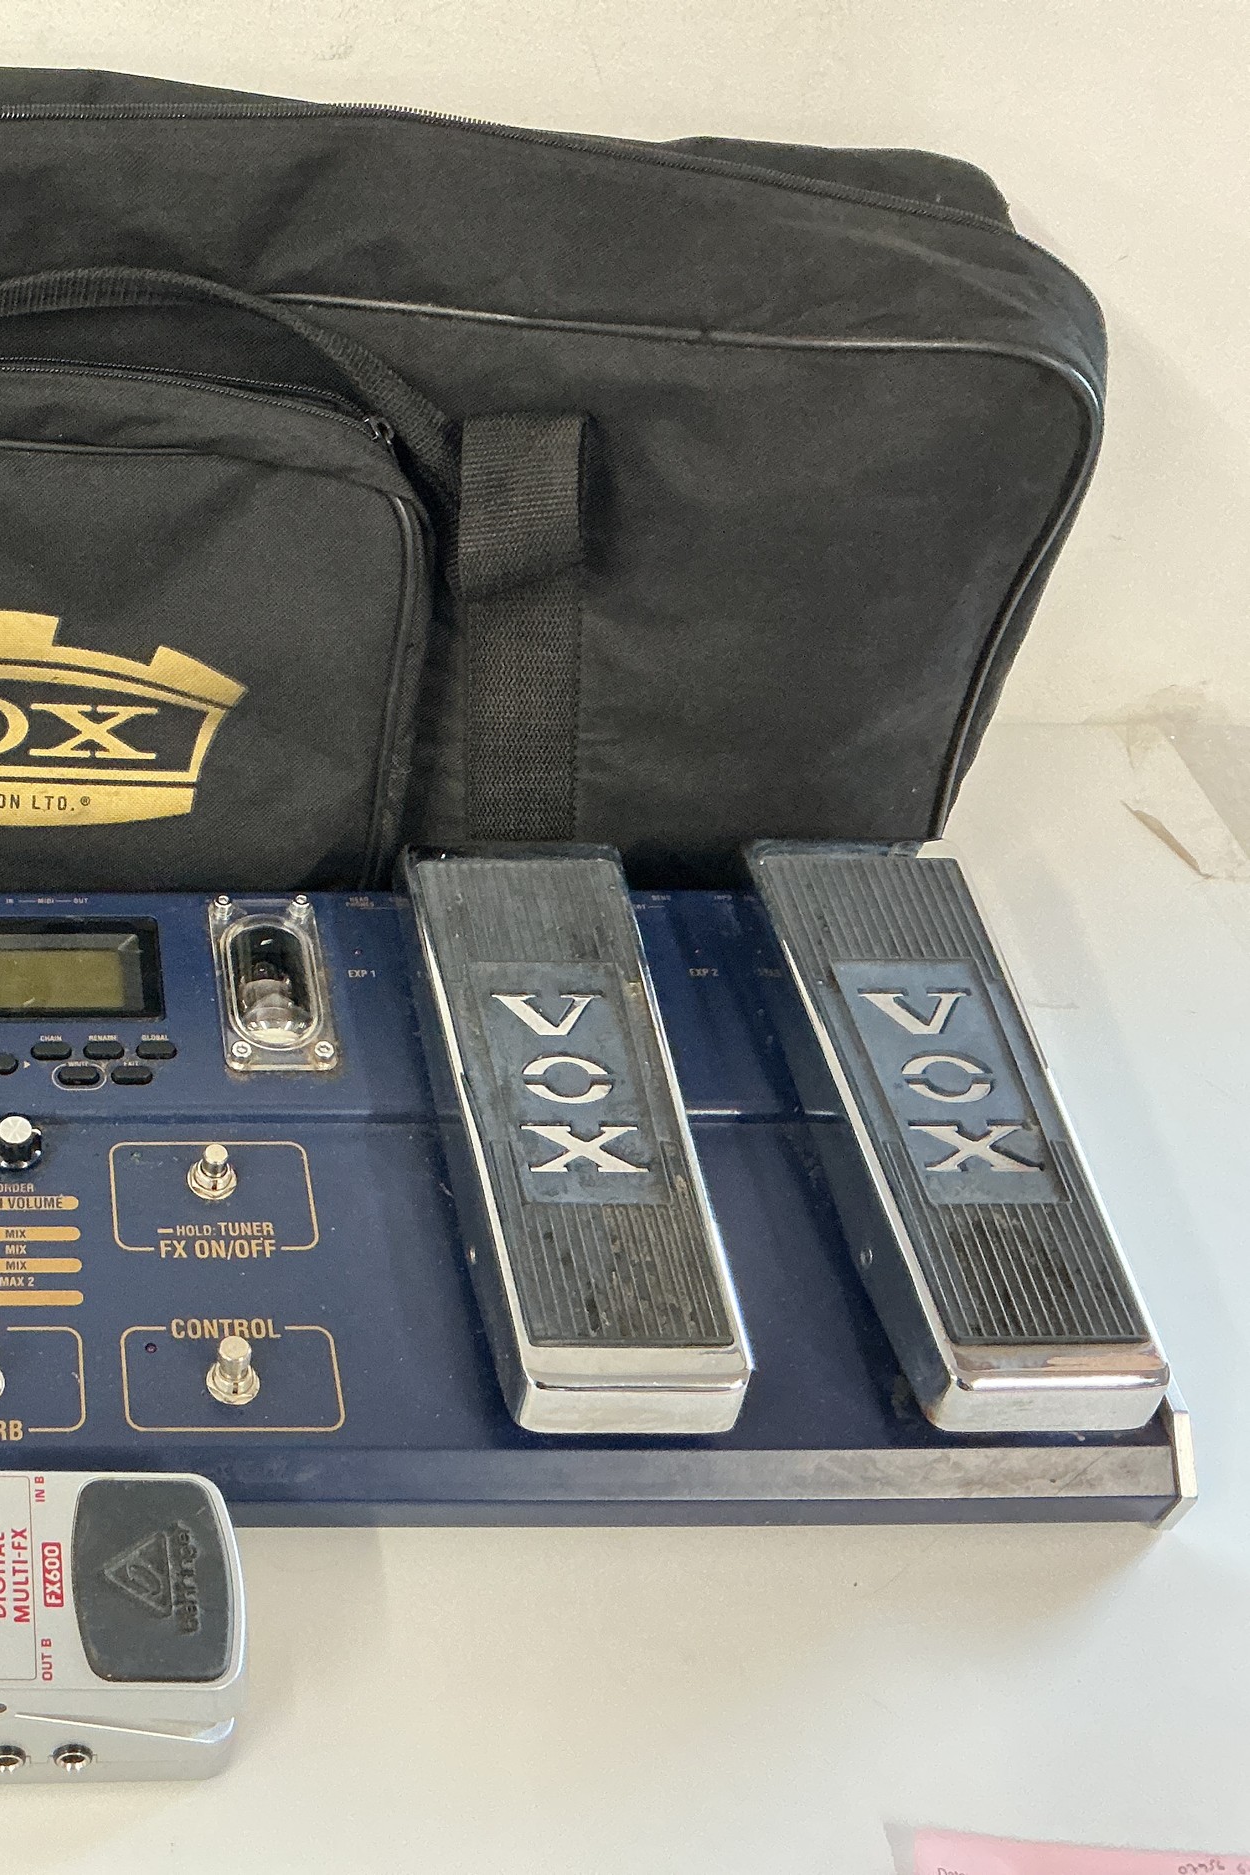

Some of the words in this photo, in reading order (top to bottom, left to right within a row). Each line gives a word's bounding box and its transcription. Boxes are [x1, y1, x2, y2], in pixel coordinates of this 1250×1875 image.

[347, 970, 368, 978] EXP
[688, 968, 709, 977] EXP
[491, 992, 650, 1175] VOX
[856, 989, 1047, 1175] VOX
[8, 1197, 63, 1209] VOLUME
[4, 1229, 27, 1239] MIX
[217, 1222, 275, 1236] TUNER
[4, 1244, 27, 1255] MIX
[160, 1240, 188, 1258] FX
[194, 1239, 276, 1260] ON/OFF
[5, 1260, 28, 1271] MIX
[26, 1276, 35, 1287] 2
[171, 1318, 282, 1339] CONTROL
[35, 1476, 45, 1484] B
[35, 1490, 45, 1502] IN
[11, 1528, 30, 1623] MULTI-FX
[44, 1546, 62, 1604] FX600
[41, 1638, 52, 1647] B
[42, 1653, 53, 1681] OUT
